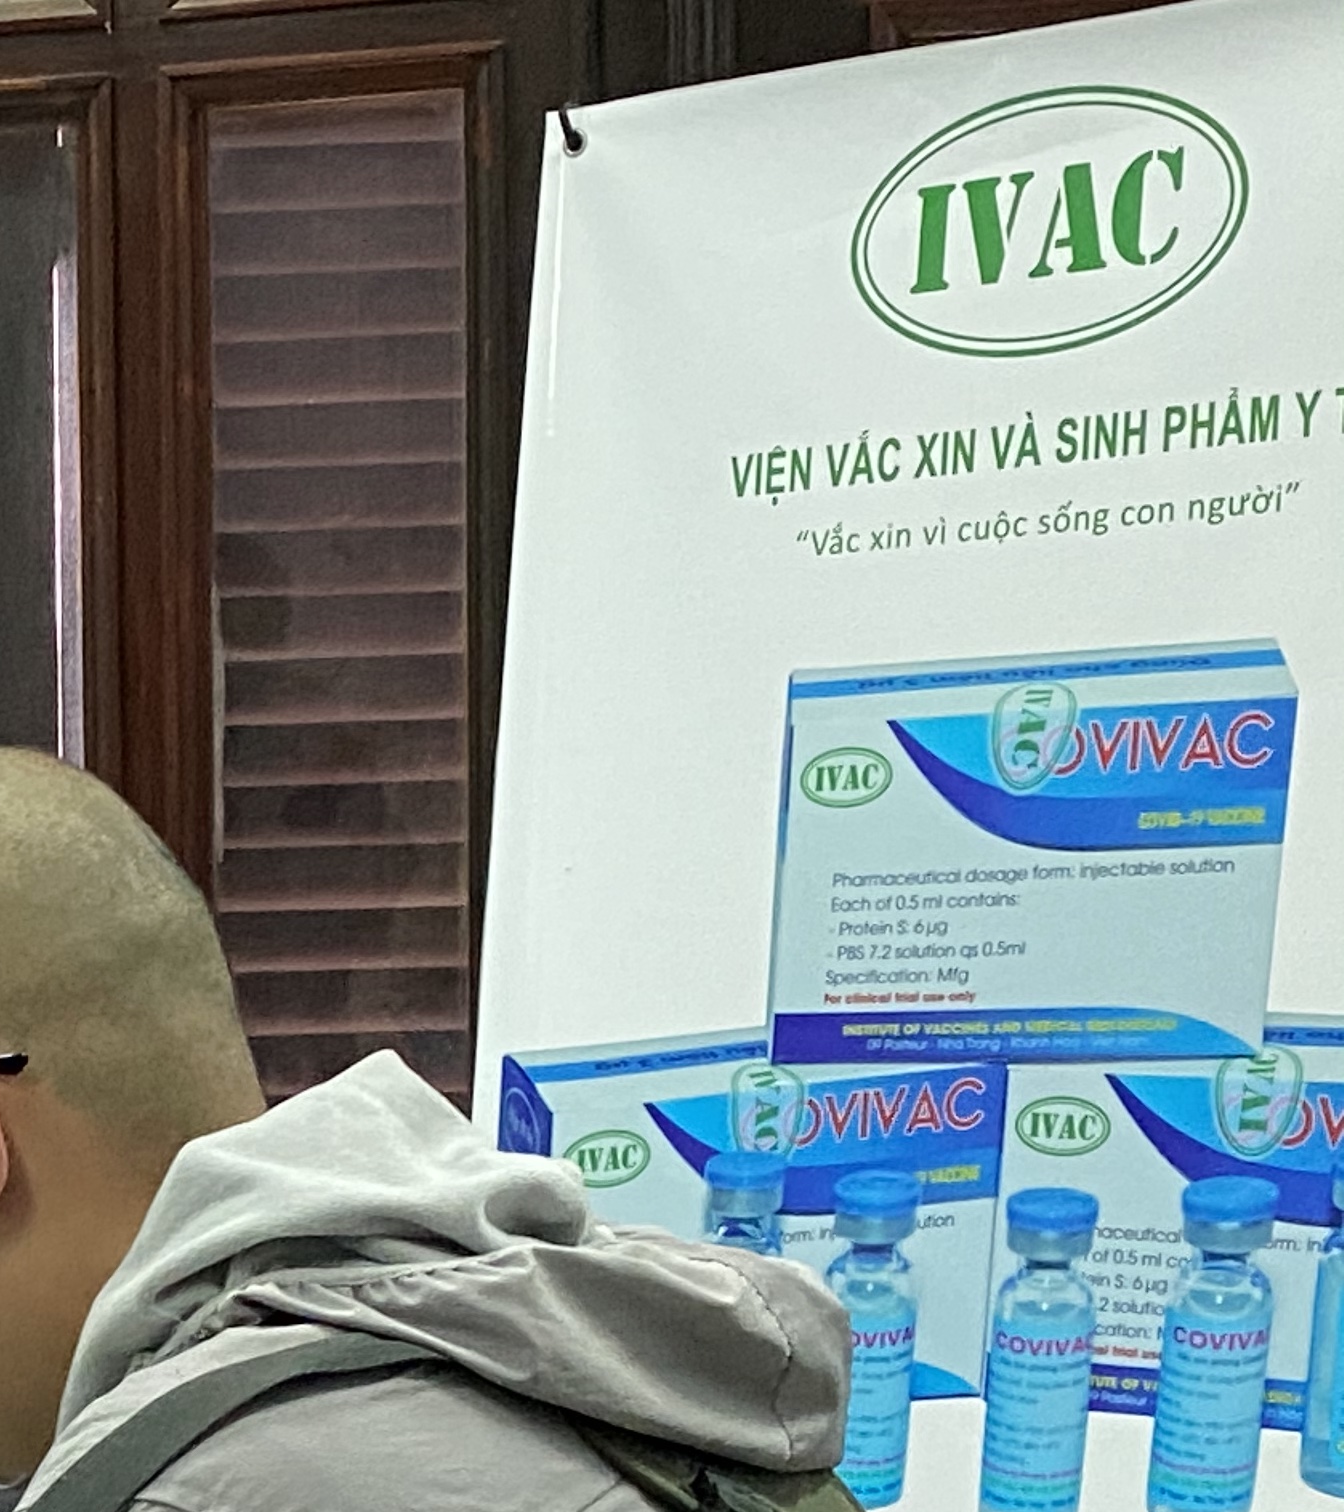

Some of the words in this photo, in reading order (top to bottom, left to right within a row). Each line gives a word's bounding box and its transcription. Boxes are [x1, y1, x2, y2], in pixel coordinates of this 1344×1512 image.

[910, 146, 1184, 294] IVAC
[731, 445, 812, 507] VIỆN
[826, 429, 901, 487] VẮC
[914, 428, 976, 479] XIN
[990, 410, 1041, 470] VÀ
[1056, 409, 1148, 463] SINH
[1163, 387, 1280, 452] PHẨM
[1295, 389, 1322, 438] Y
[870, 523, 911, 551] xin
[923, 516, 946, 546] vì
[958, 510, 1028, 544] cuộc
[1037, 500, 1109, 536] sống
[1120, 501, 1174, 526] con
[815, 763, 879, 791] IVAC
[832, 871, 961, 887] Pharmaceutical
[966, 868, 1027, 885] dosage
[1033, 864, 1073, 880] form:
[1080, 861, 1166, 881] injectable
[1170, 858, 1235, 875] solution
[831, 897, 871, 913] Each
[875, 896, 893, 911] of
[895, 894, 919, 910] 0.5
[923, 895, 943, 909] ml
[947, 893, 1021, 908] contains:
[839, 921, 893, 936] Protein
[895, 944, 956, 959] solution
[825, 969, 931, 986] Specification:
[937, 967, 970, 985] Mfg
[1030, 1112, 1097, 1141] IVAC
[577, 1144, 638, 1173] IVAC
[1113, 1251, 1138, 1266] 0.5
